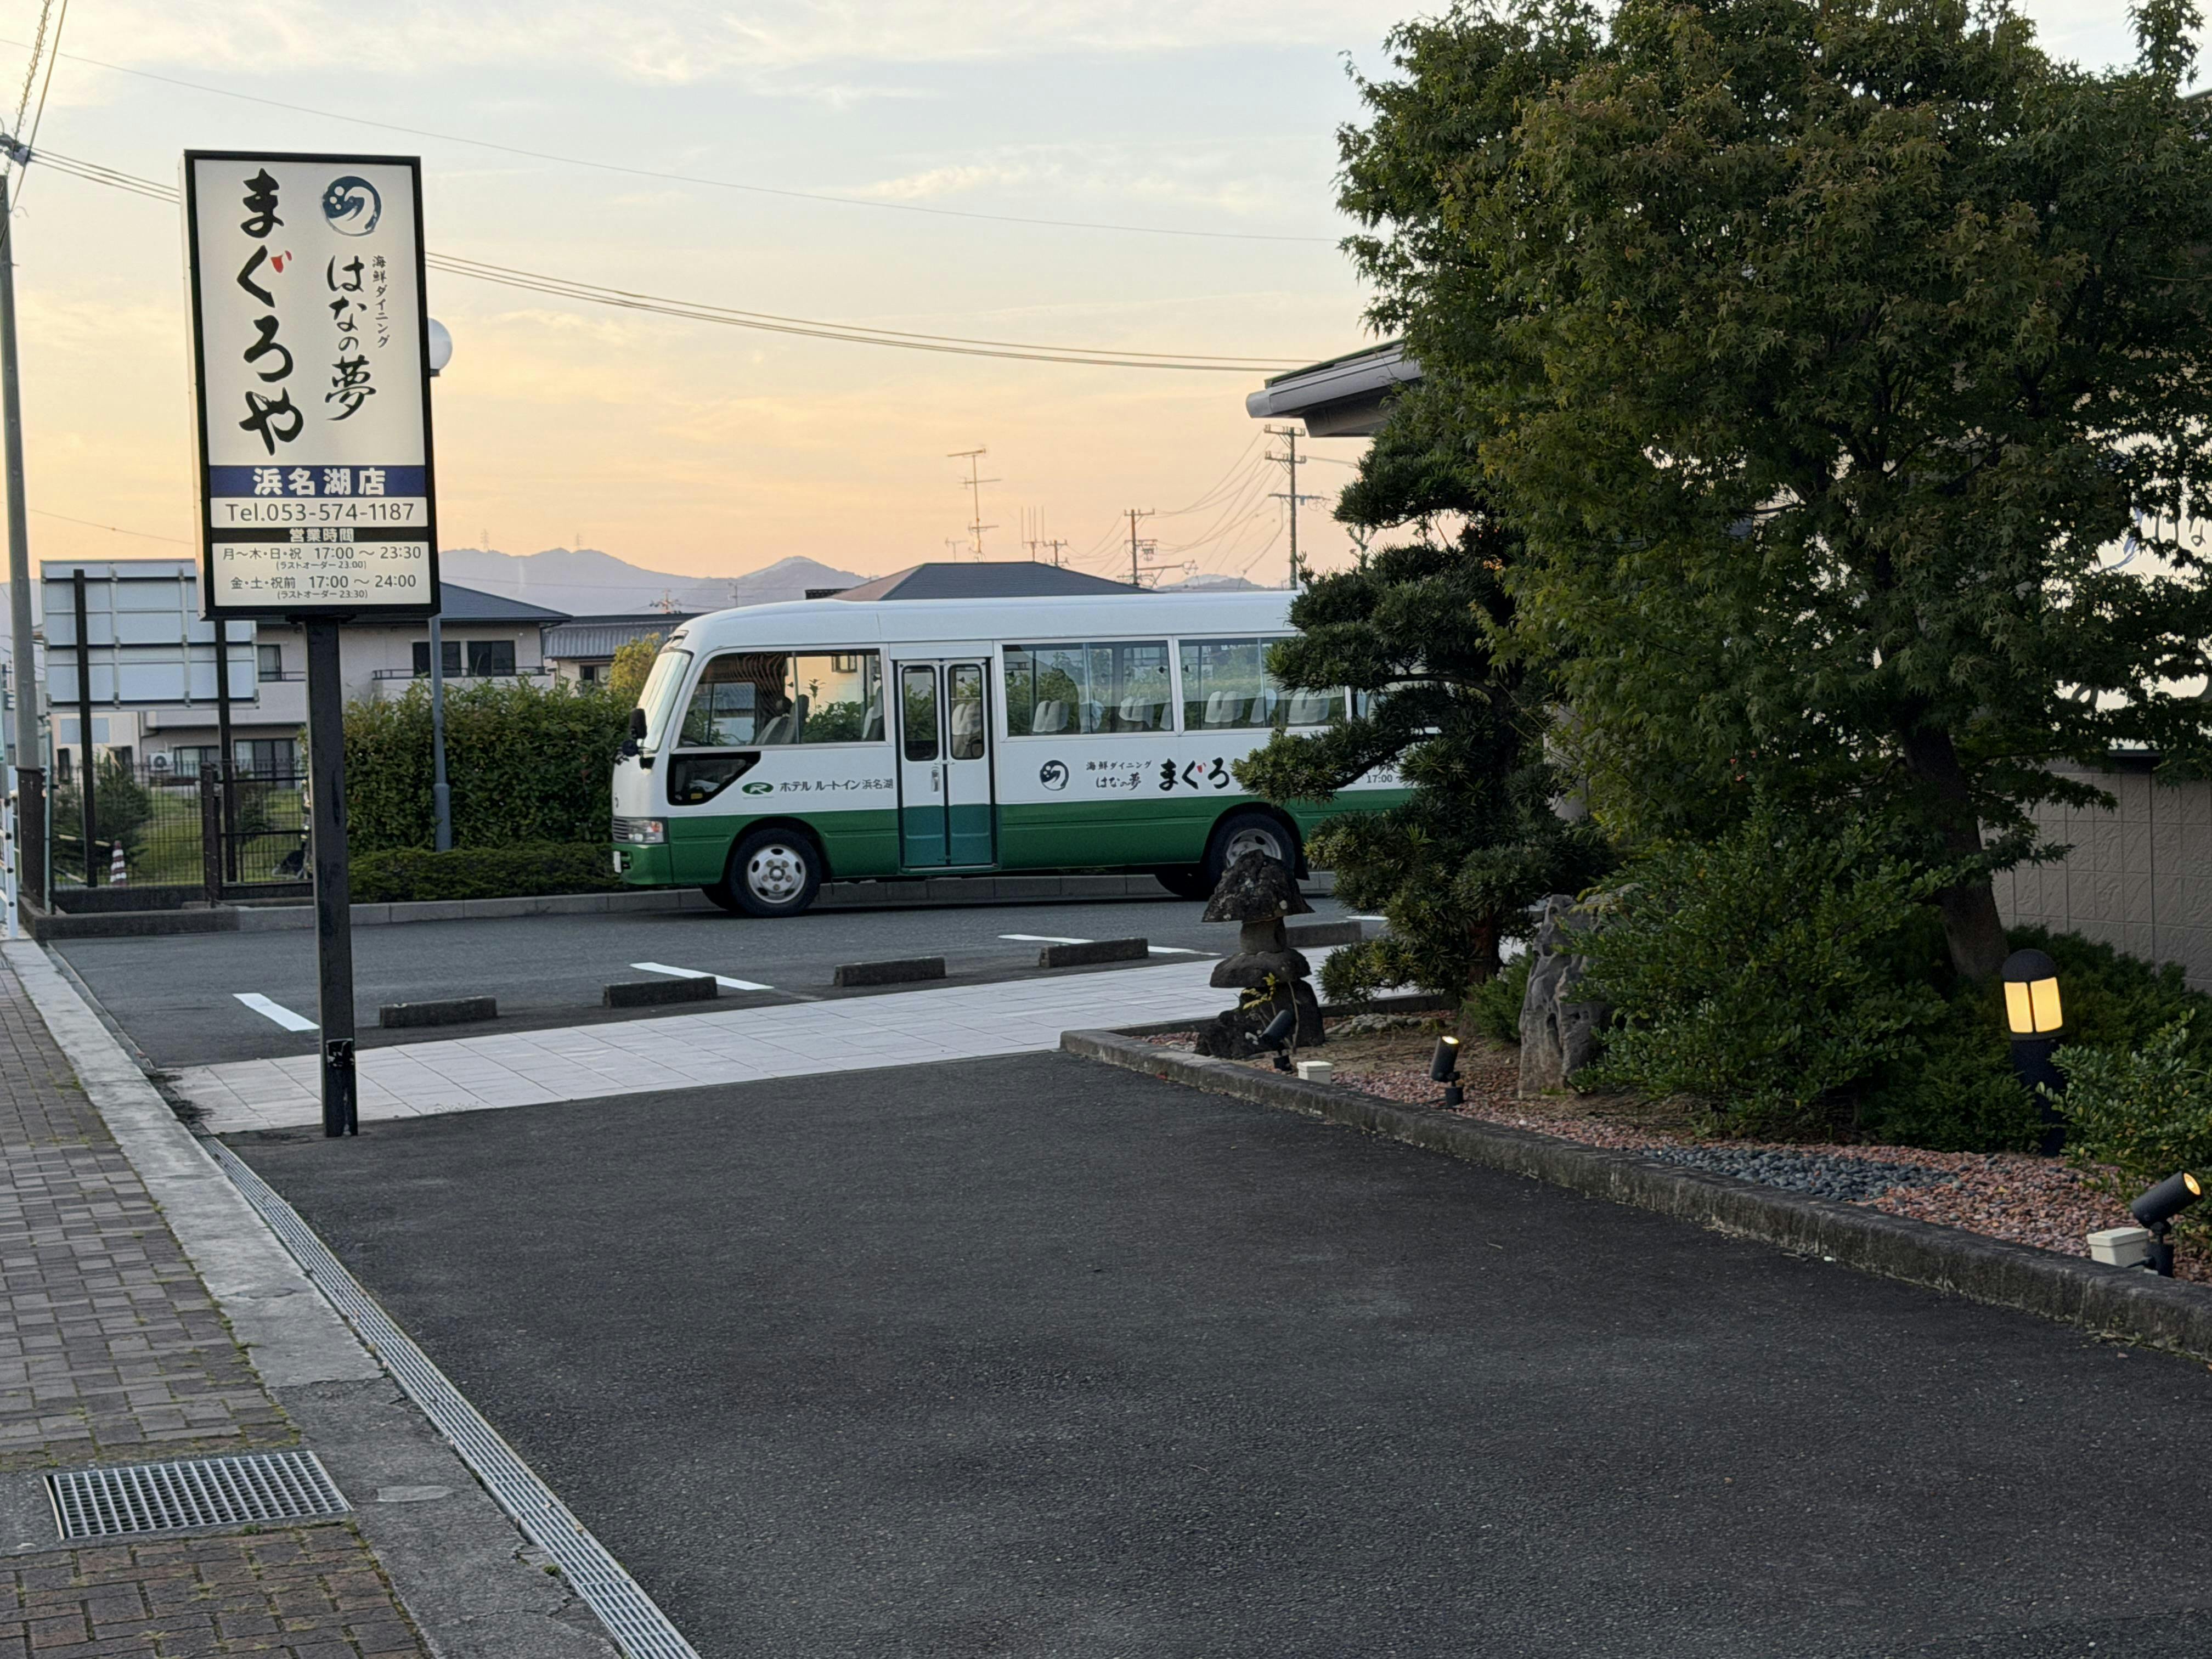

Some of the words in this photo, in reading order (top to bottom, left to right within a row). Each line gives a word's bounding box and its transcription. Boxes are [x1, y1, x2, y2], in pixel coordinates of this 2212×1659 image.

[372, 255, 390, 348] 海鮮ダイニング
[237, 168, 303, 456] まぐろや
[325, 255, 377, 421] はなの夢
[253, 468, 385, 495] 浜名湖店
[225, 503, 414, 521] Tel.053-574-1187
[289, 528, 354, 543] 営業時間
[314, 546, 354, 560] 17:00
[381, 546, 421, 558] 23:30
[309, 575, 348, 588] 17:00
[375, 575, 416, 587] 24:00
[1086, 761, 1151, 770] 海鮮ダイニング
[1096, 772, 1142, 791] はなの夢
[1367, 774, 1393, 783] 17:00
